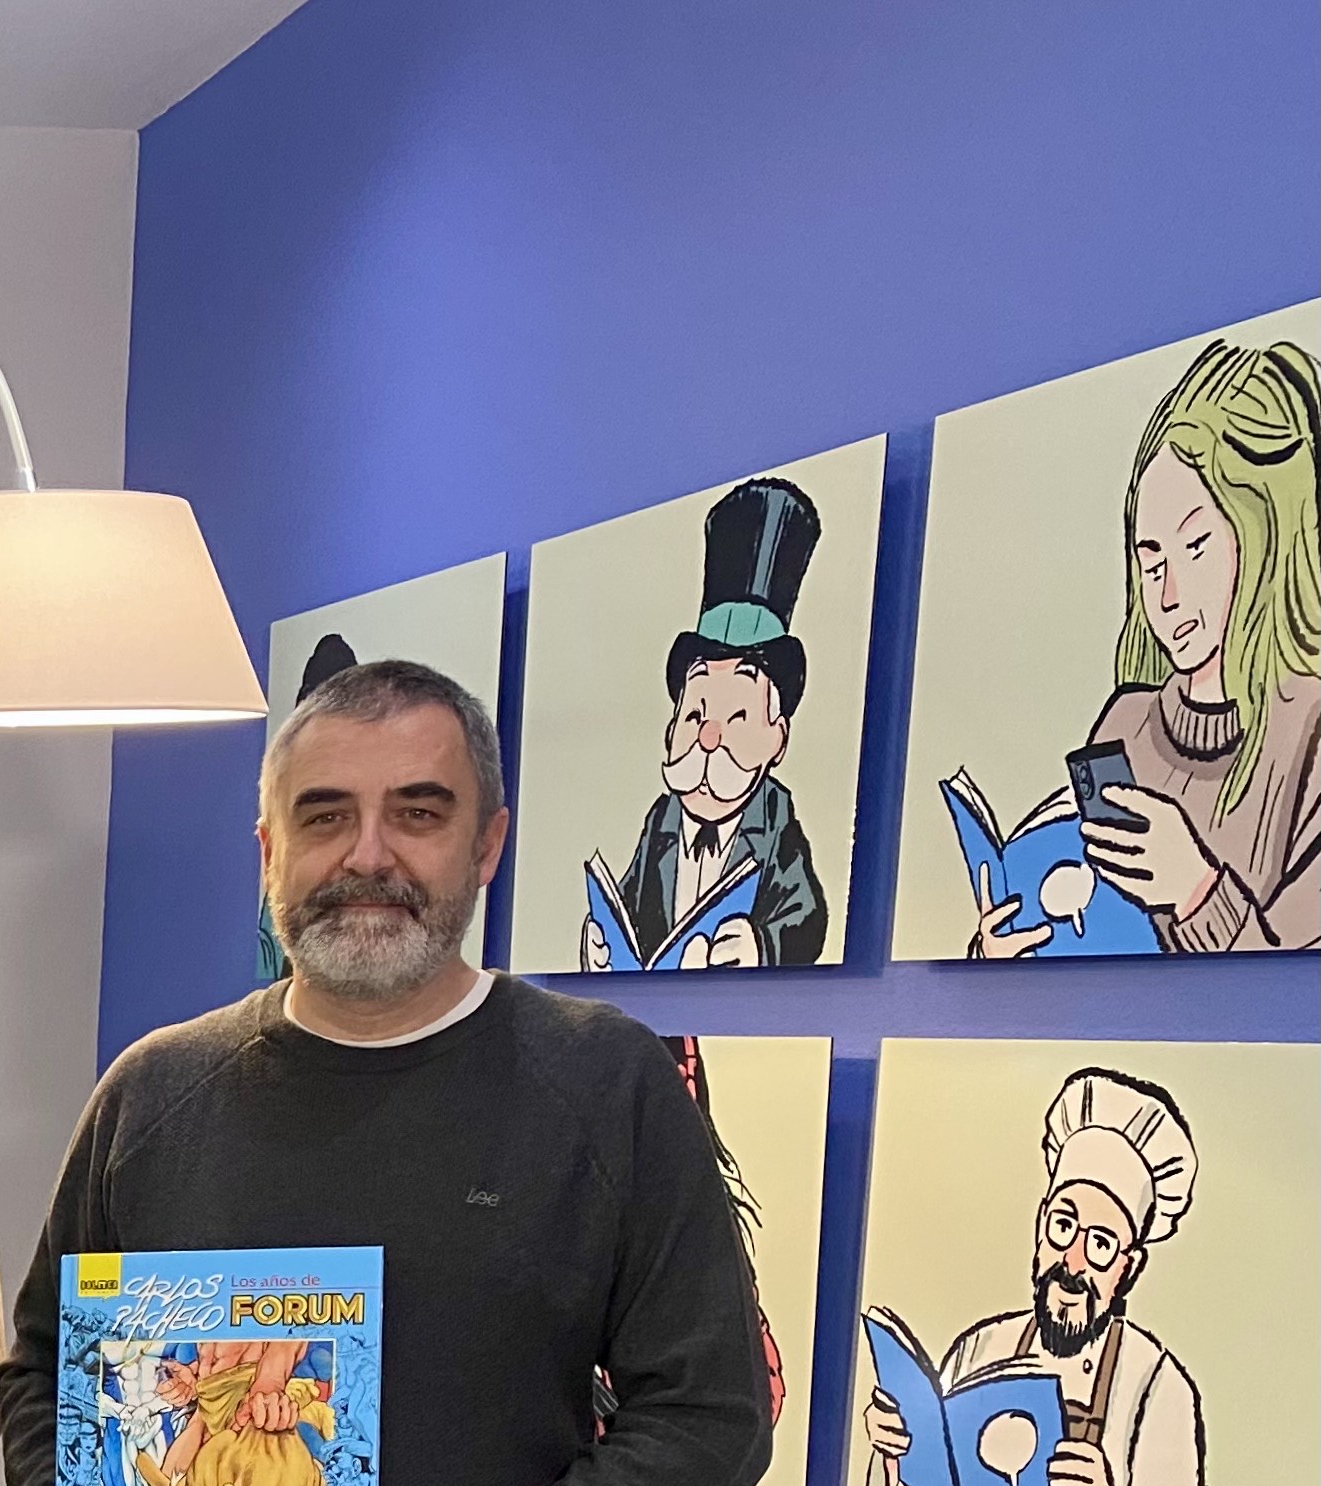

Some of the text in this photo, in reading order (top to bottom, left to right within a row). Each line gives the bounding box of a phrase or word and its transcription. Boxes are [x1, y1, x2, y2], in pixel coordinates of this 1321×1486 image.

[466, 1187, 499, 1207] Lee
[231, 1273, 320, 1287] Los años de
[230, 1292, 365, 1327] FORUM
